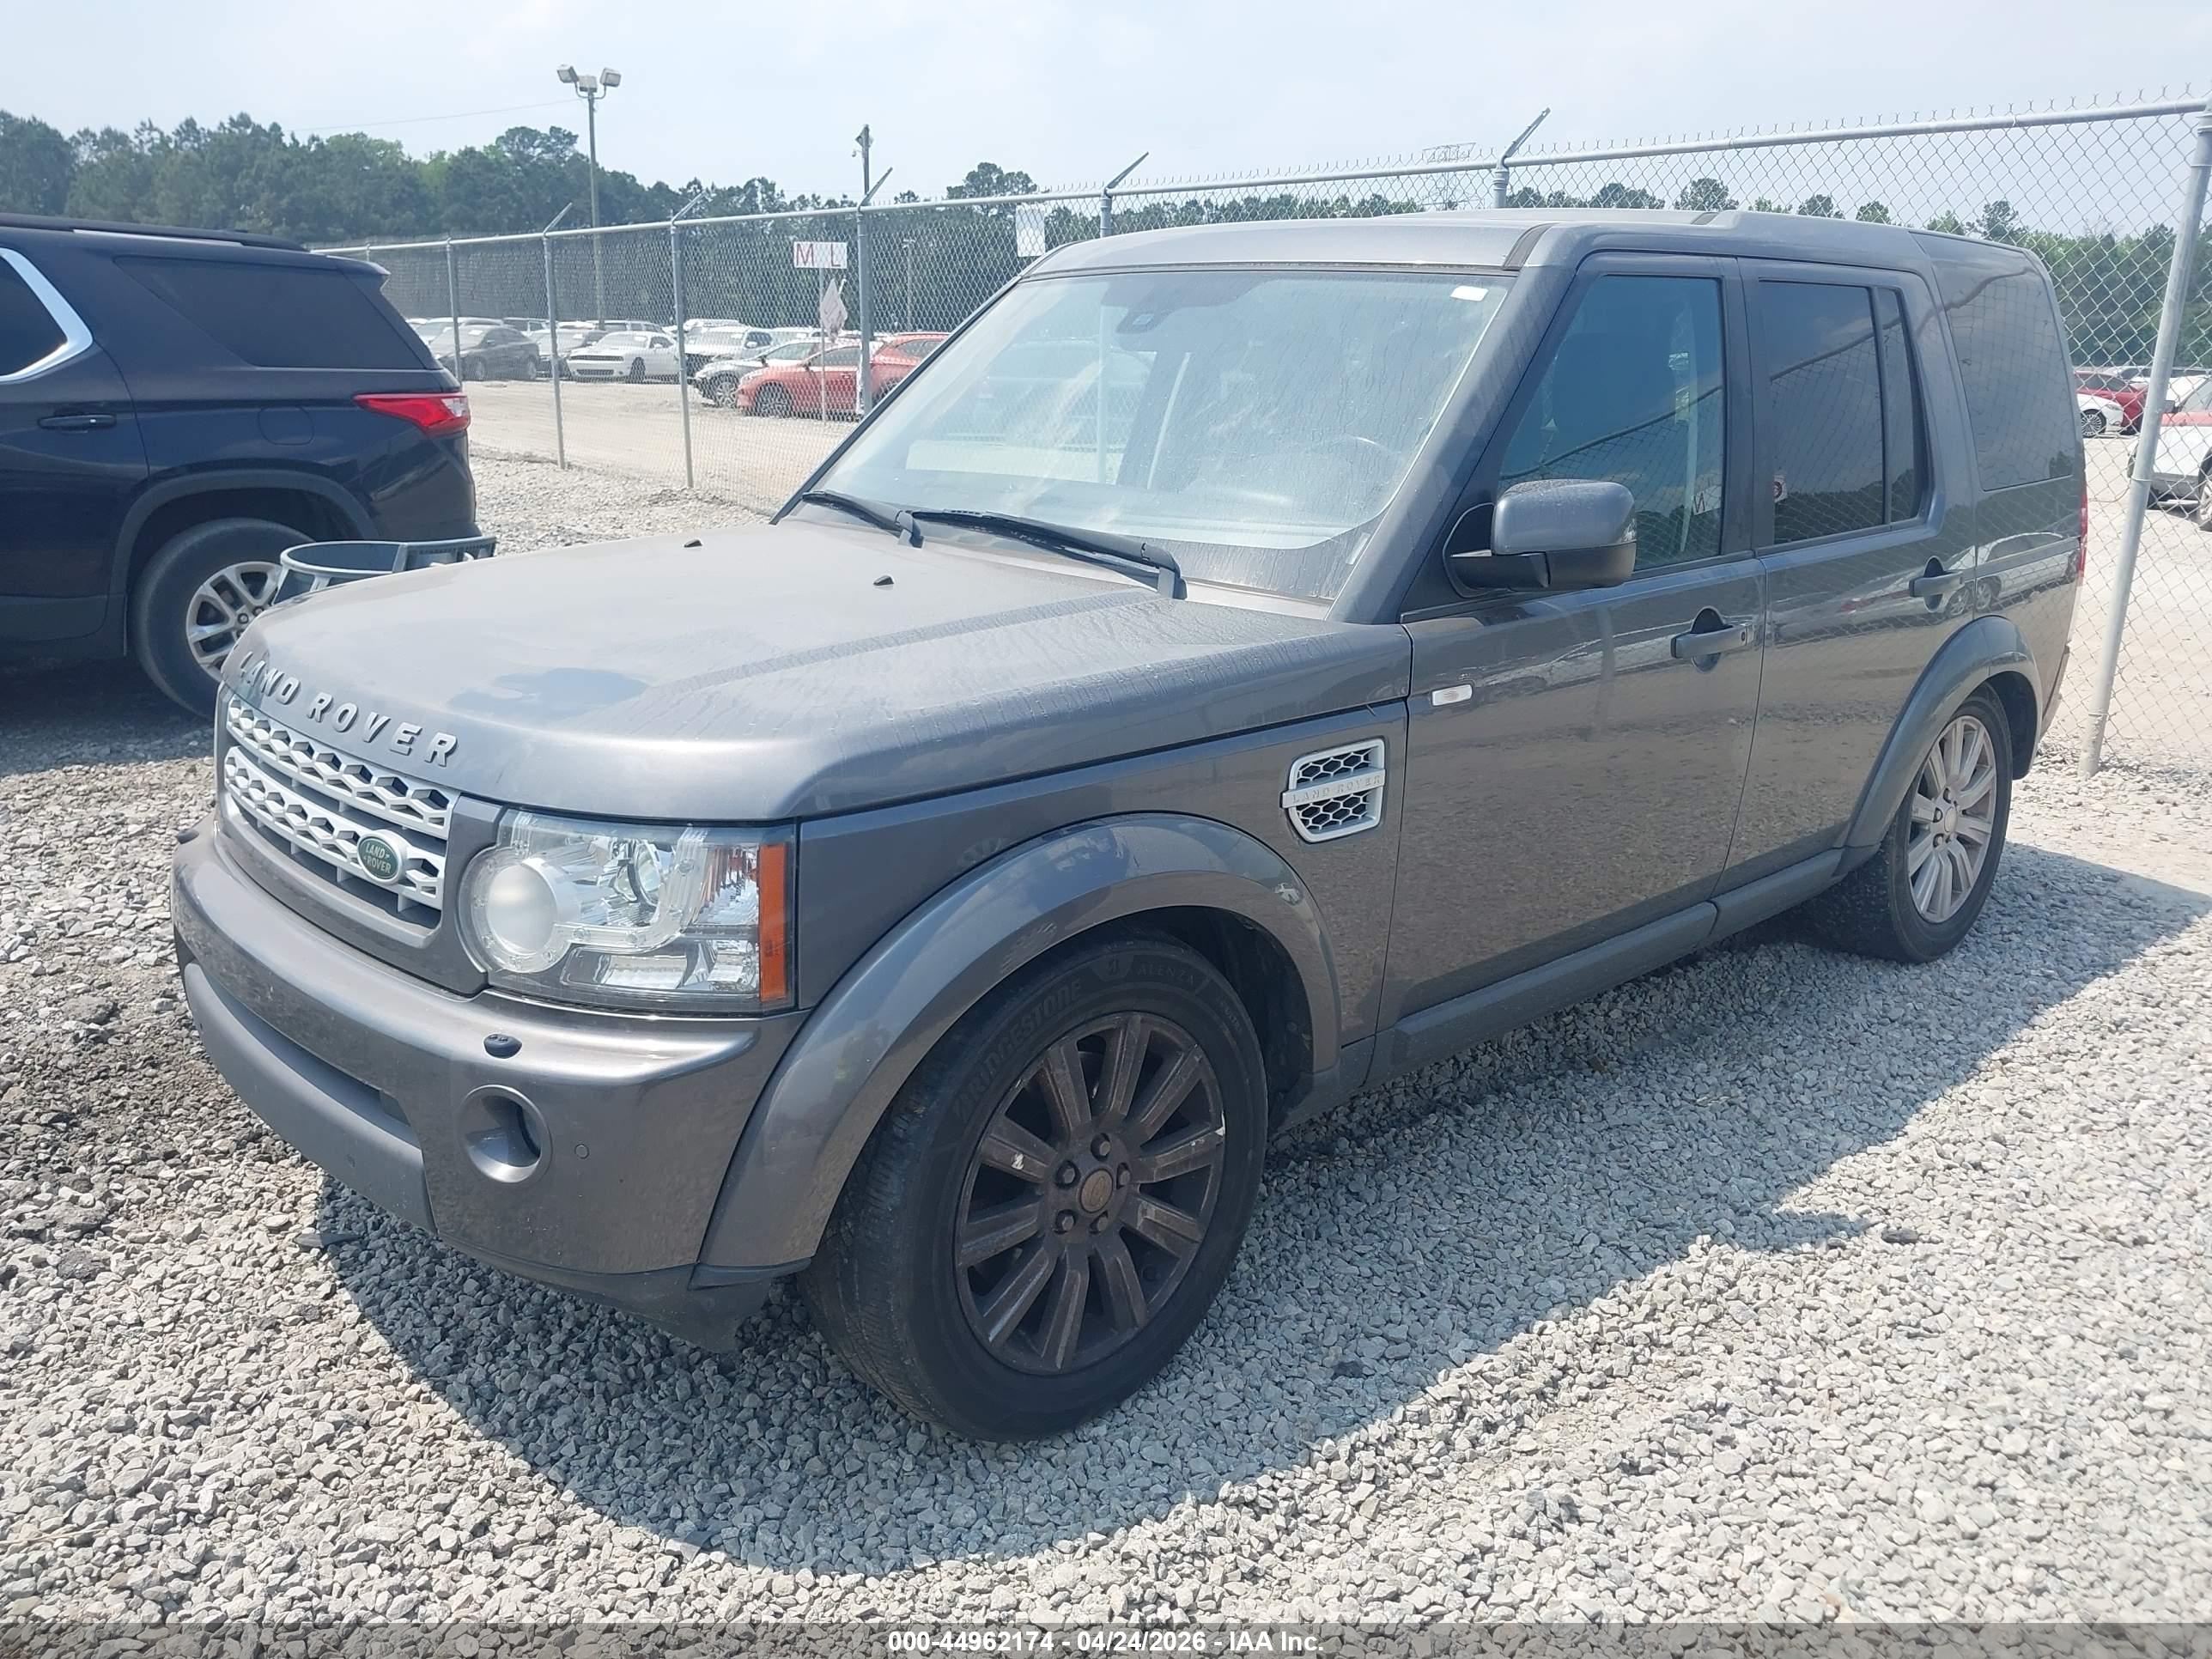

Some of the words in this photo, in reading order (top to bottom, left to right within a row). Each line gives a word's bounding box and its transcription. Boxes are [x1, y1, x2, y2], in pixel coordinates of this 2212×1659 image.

[797, 243, 814, 266] M
[830, 243, 841, 267] L
[240, 652, 301, 705] LAND
[307, 692, 459, 768] ROVER
[1292, 787, 1330, 804] LAND
[1337, 775, 1381, 794] ROVER
[366, 842, 386, 860] LAND
[367, 856, 392, 874] ROVER
